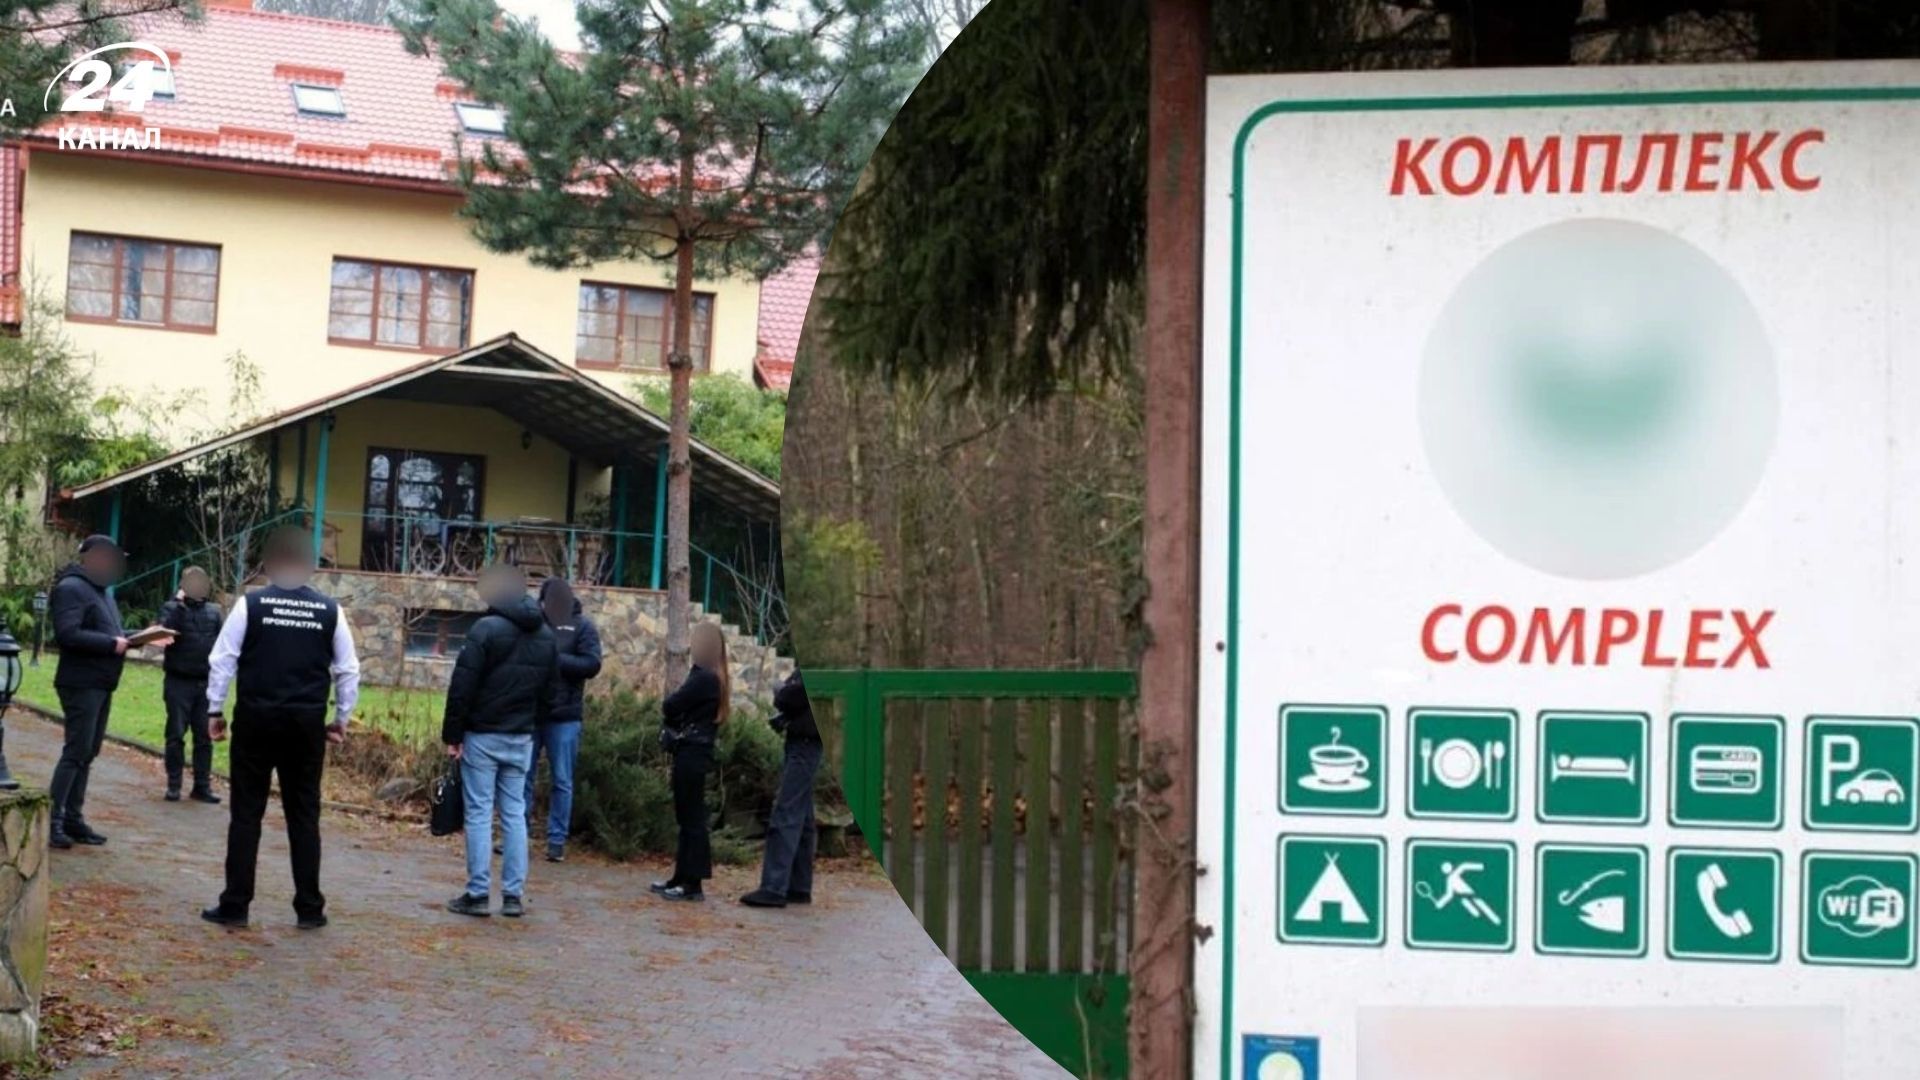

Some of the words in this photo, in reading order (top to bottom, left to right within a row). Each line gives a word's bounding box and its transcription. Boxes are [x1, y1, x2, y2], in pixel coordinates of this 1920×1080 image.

[1390, 129, 1825, 195] КОМПЛЕКС
[260, 597, 327, 609] ЗАКАРПАТСЬКА
[272, 607, 315, 619] ОБЛАСНА
[262, 616, 323, 630] ПРОКУРАТУРА
[1420, 603, 1776, 669] COMPLEX
